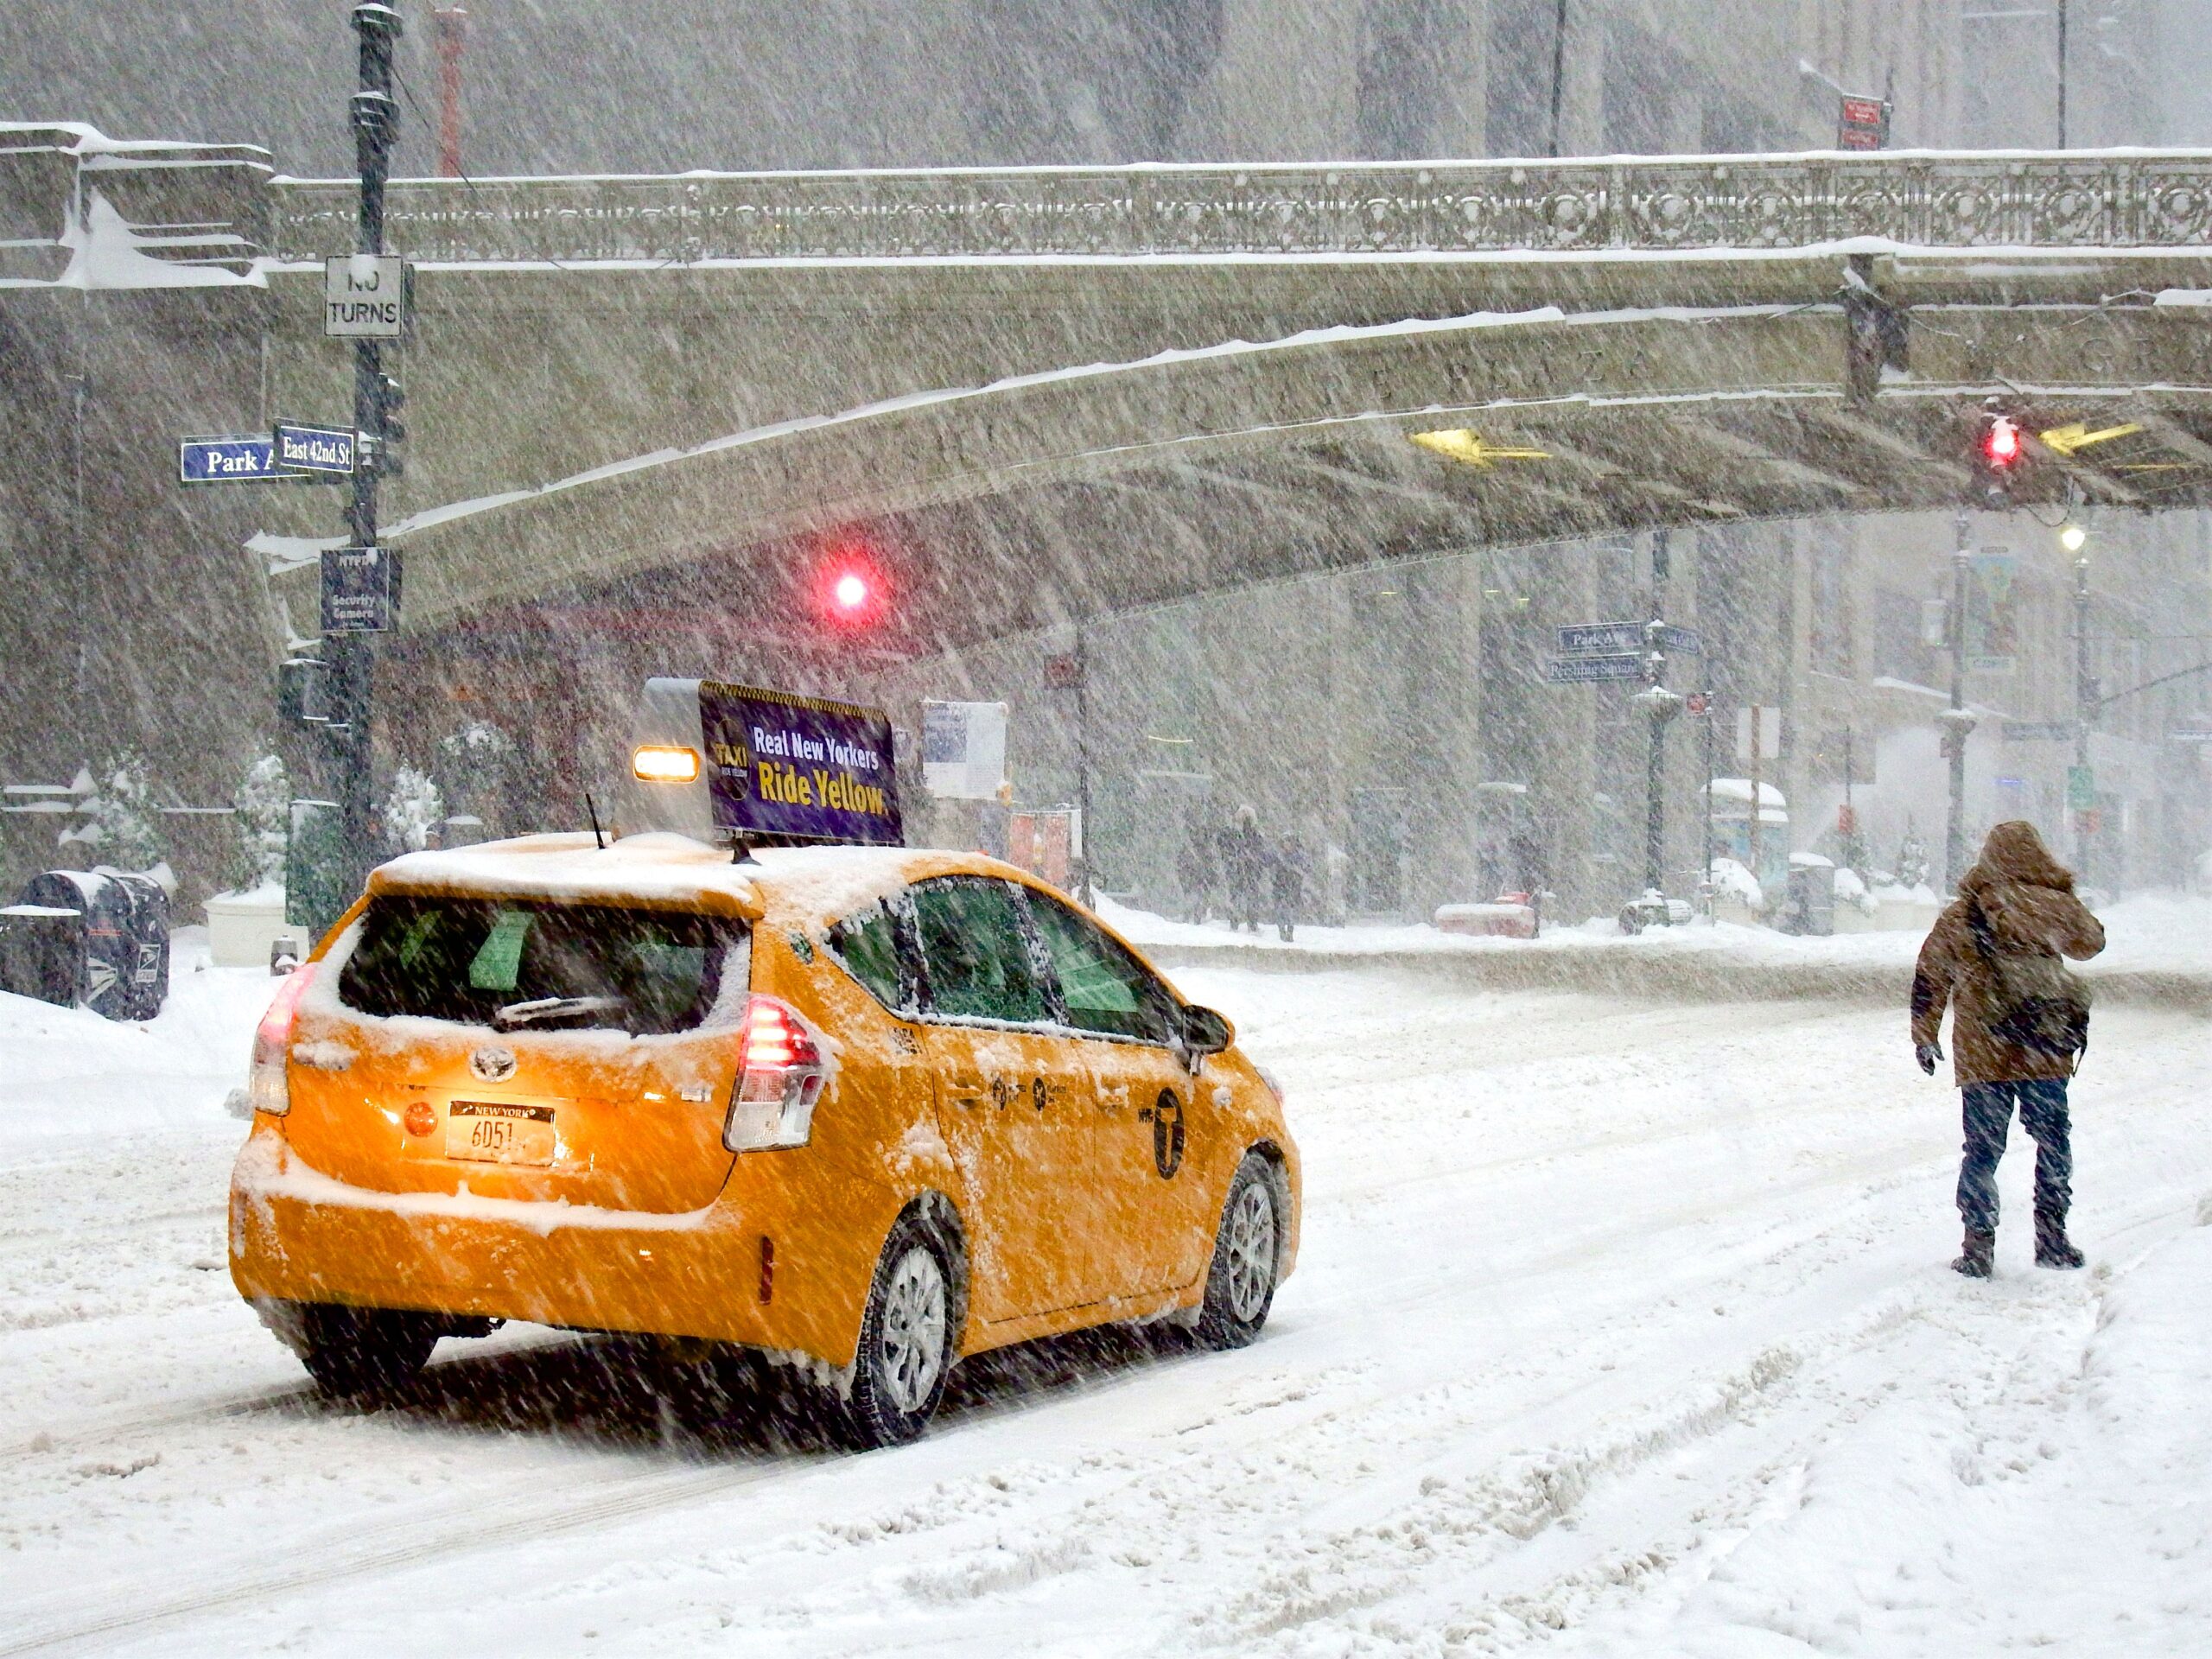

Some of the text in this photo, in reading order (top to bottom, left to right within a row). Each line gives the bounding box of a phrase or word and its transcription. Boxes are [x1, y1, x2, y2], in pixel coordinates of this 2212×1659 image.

[329, 302, 396, 323] TURNS
[207, 450, 258, 473] Park
[283, 436, 350, 465] East 42nd St
[333, 594, 375, 607] Security
[334, 607, 374, 619] Camera
[1573, 632, 1602, 646] Park
[715, 742, 747, 767] TAXI
[753, 727, 879, 771] Real New Yorkers
[758, 761, 811, 806] Ride
[475, 1106, 529, 1118] NEW YORK
